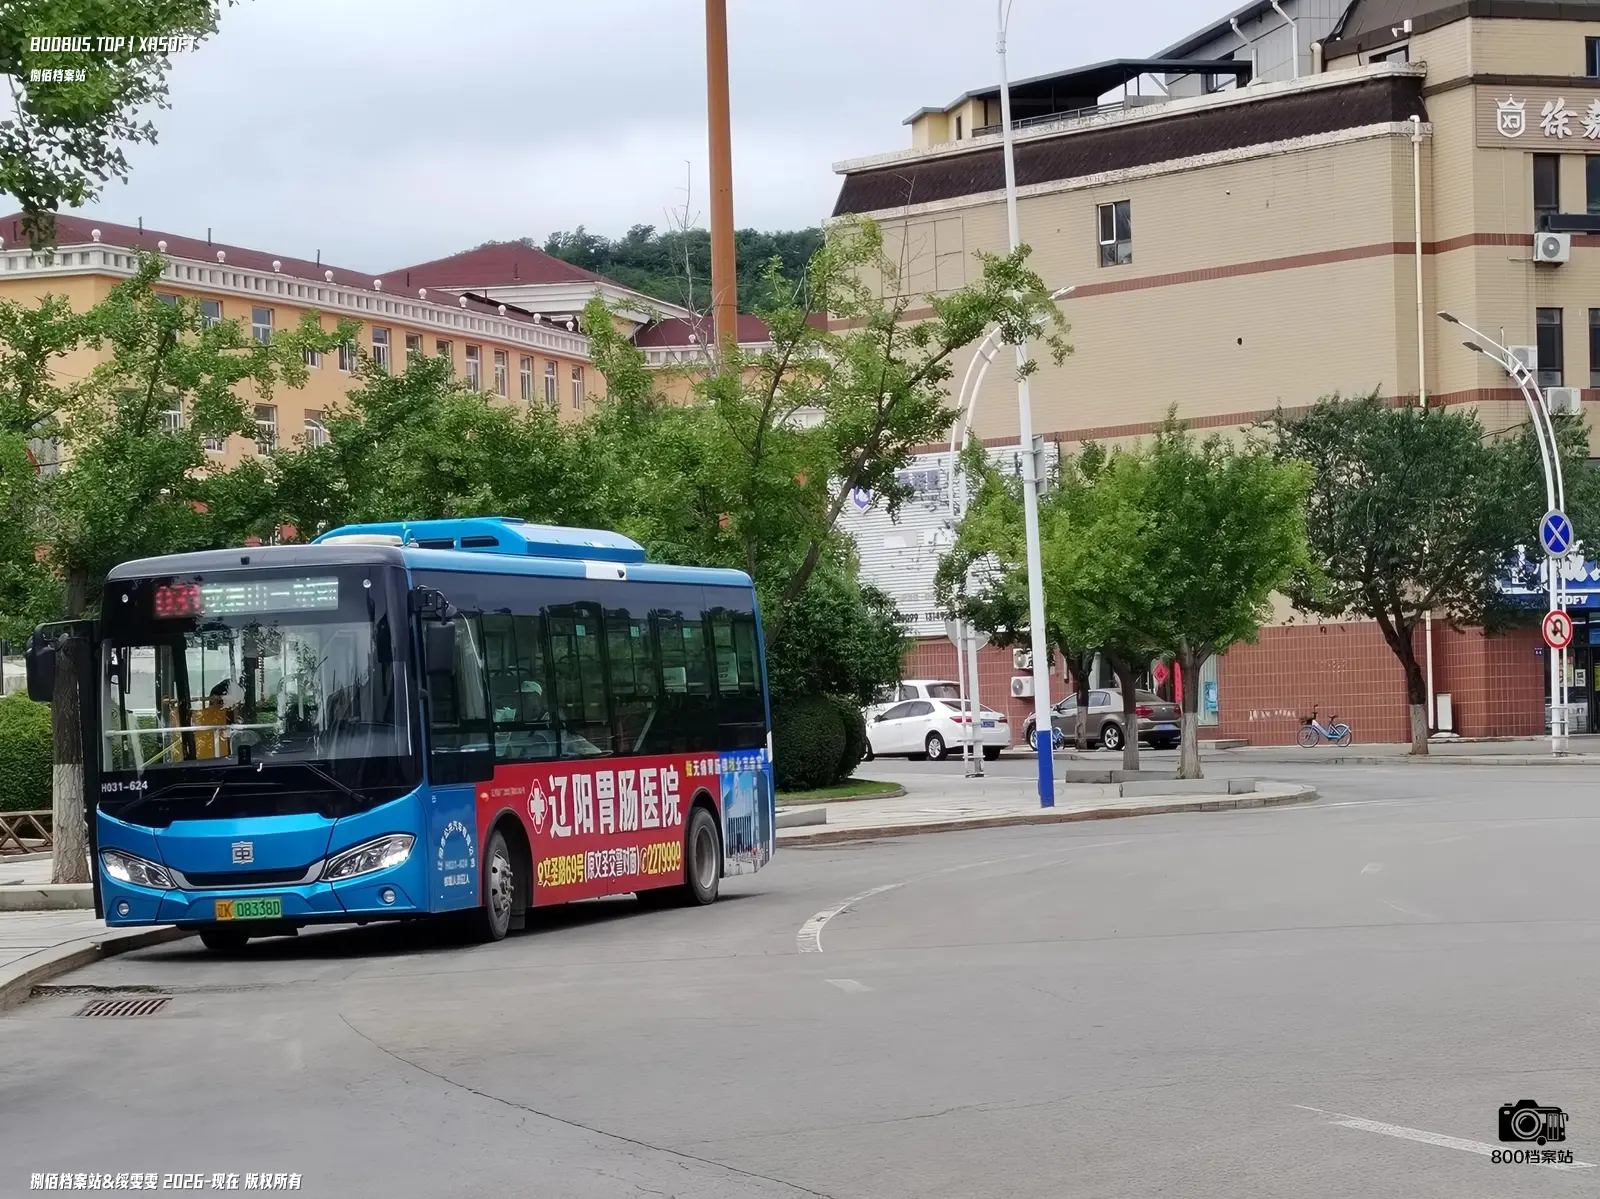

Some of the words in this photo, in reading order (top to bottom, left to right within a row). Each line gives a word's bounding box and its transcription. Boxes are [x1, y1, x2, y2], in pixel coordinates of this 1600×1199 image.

[101, 781, 148, 793] H031-624
[548, 764, 683, 839] 辽阳胃肠医院
[648, 841, 681, 875] 2279999
